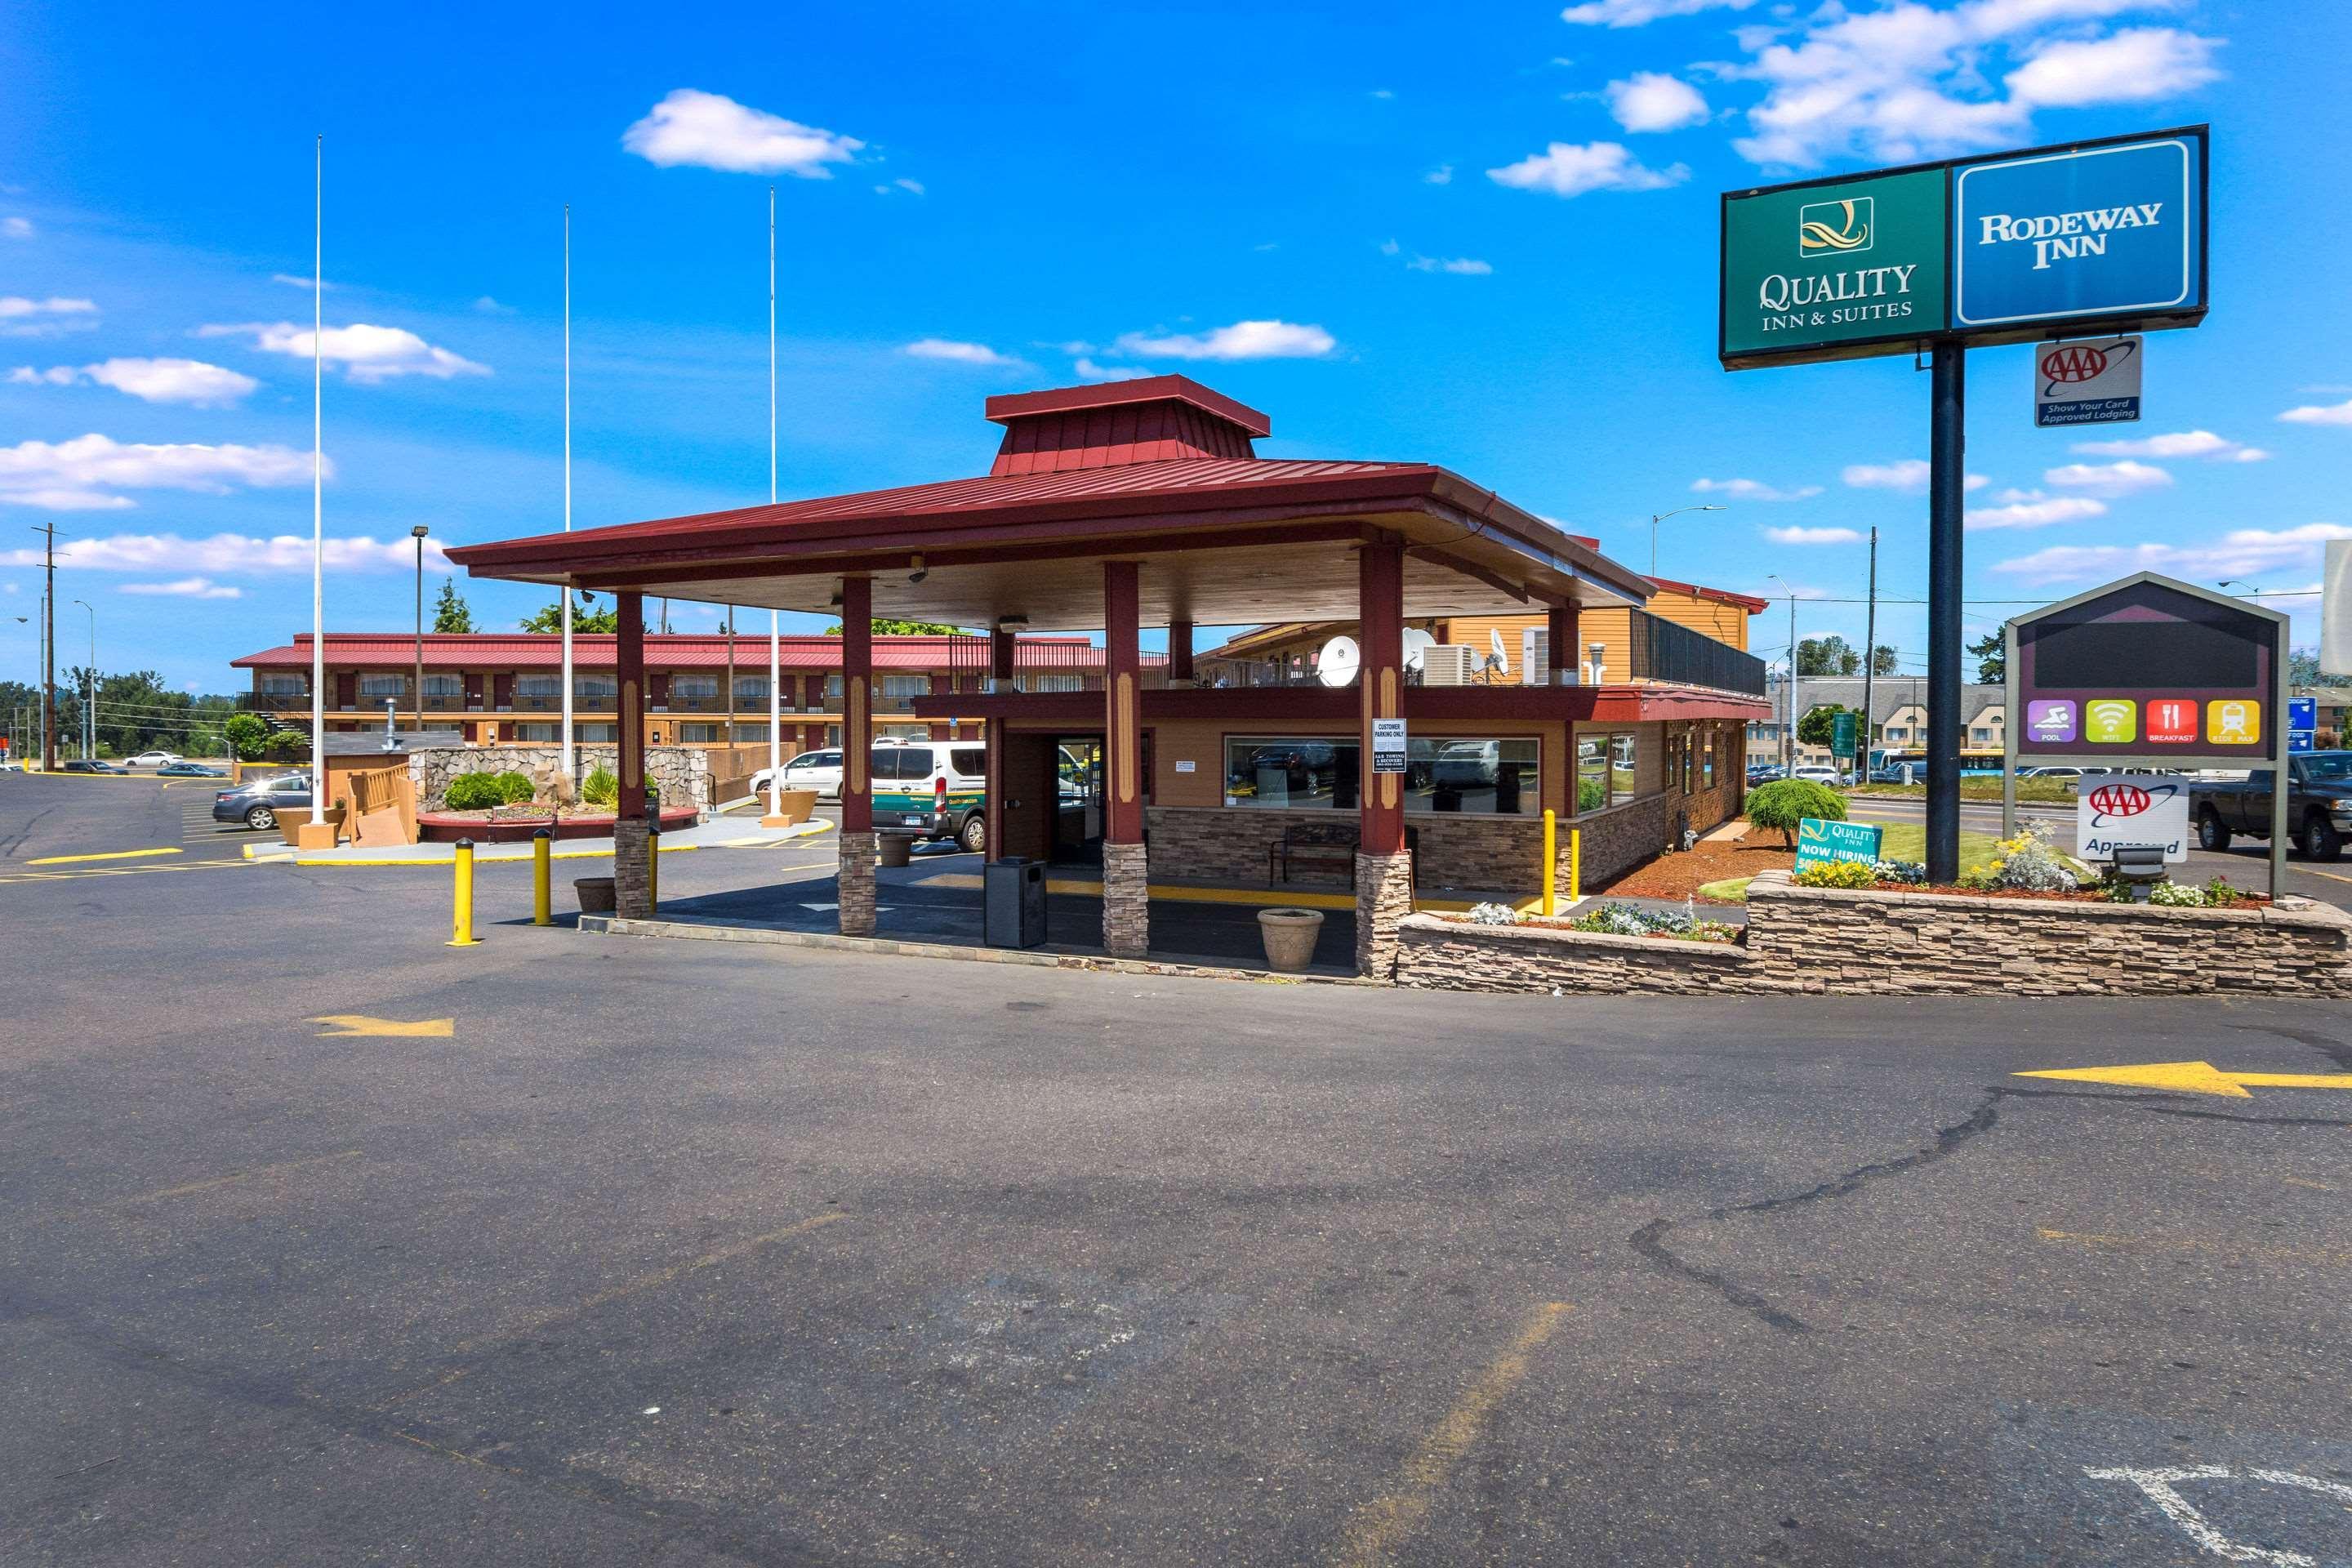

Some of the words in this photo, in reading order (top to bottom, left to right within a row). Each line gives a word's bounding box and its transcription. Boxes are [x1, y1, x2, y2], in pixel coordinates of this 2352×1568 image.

[1979, 203, 2163, 245] RODEWAY
[2033, 234, 2107, 270] INN
[1760, 265, 1917, 312] QUALITY
[1762, 314, 1805, 331] INN
[1811, 312, 1826, 326] &
[1832, 301, 1913, 323] SUITES
[2048, 347, 2100, 381] AAA
[2042, 412, 2091, 423] Approved
[2094, 409, 2136, 419] Lodging
[2048, 404, 2076, 413] Show
[2079, 403, 2103, 411] Your
[2105, 399, 2130, 408] Card
[2095, 784, 2145, 816] AAA
[1832, 825, 1878, 842] QUALITY
[1844, 838, 1862, 847] INN
[1801, 844, 1831, 858] NOW
[1833, 849, 1877, 864] HIRING
